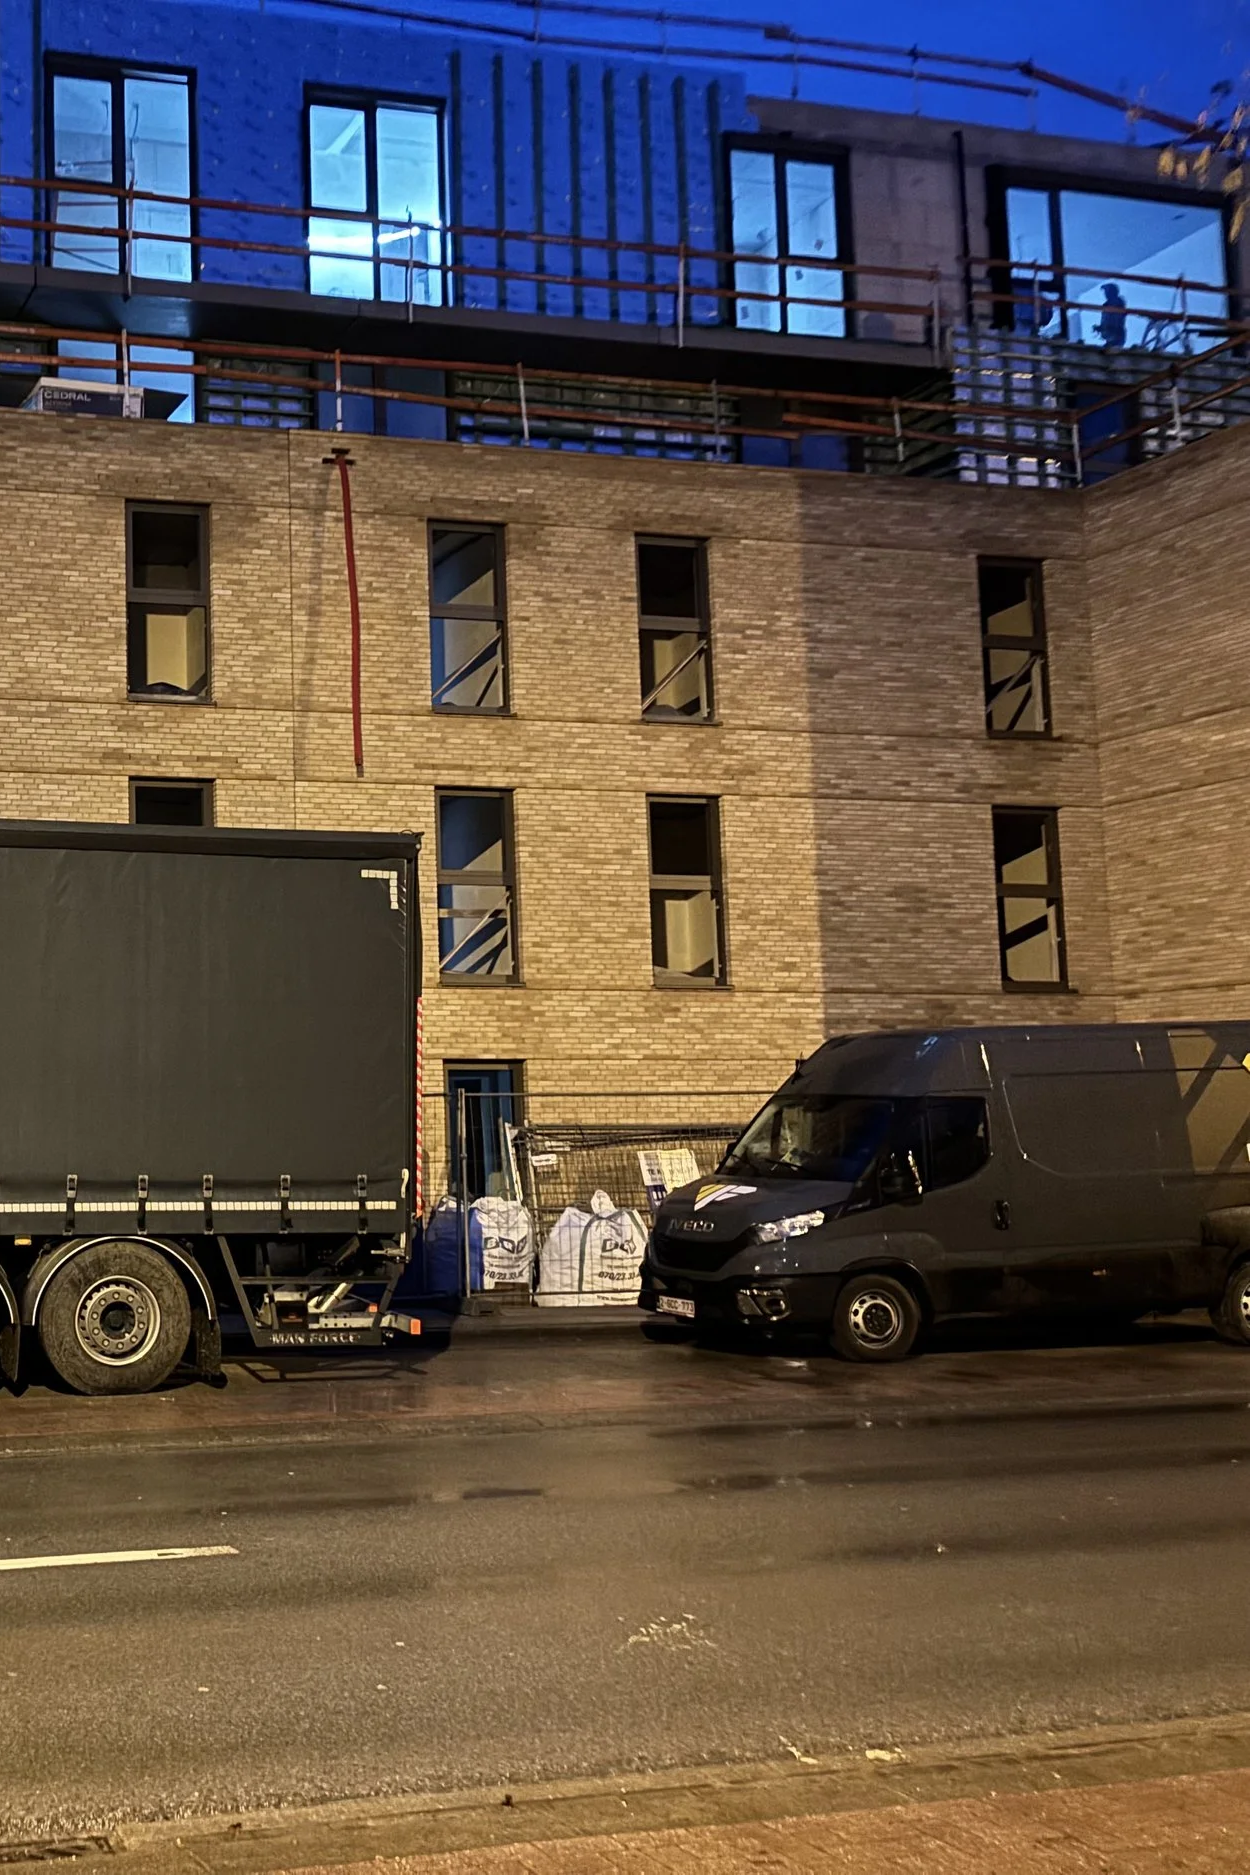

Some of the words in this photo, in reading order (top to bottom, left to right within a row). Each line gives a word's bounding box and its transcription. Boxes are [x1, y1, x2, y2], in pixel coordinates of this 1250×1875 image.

[44, 390, 92, 402] CEDRAL
[669, 1219, 715, 1232] IVECO
[271, 1333, 305, 1344] MAN
[309, 1333, 357, 1344] FORCE
